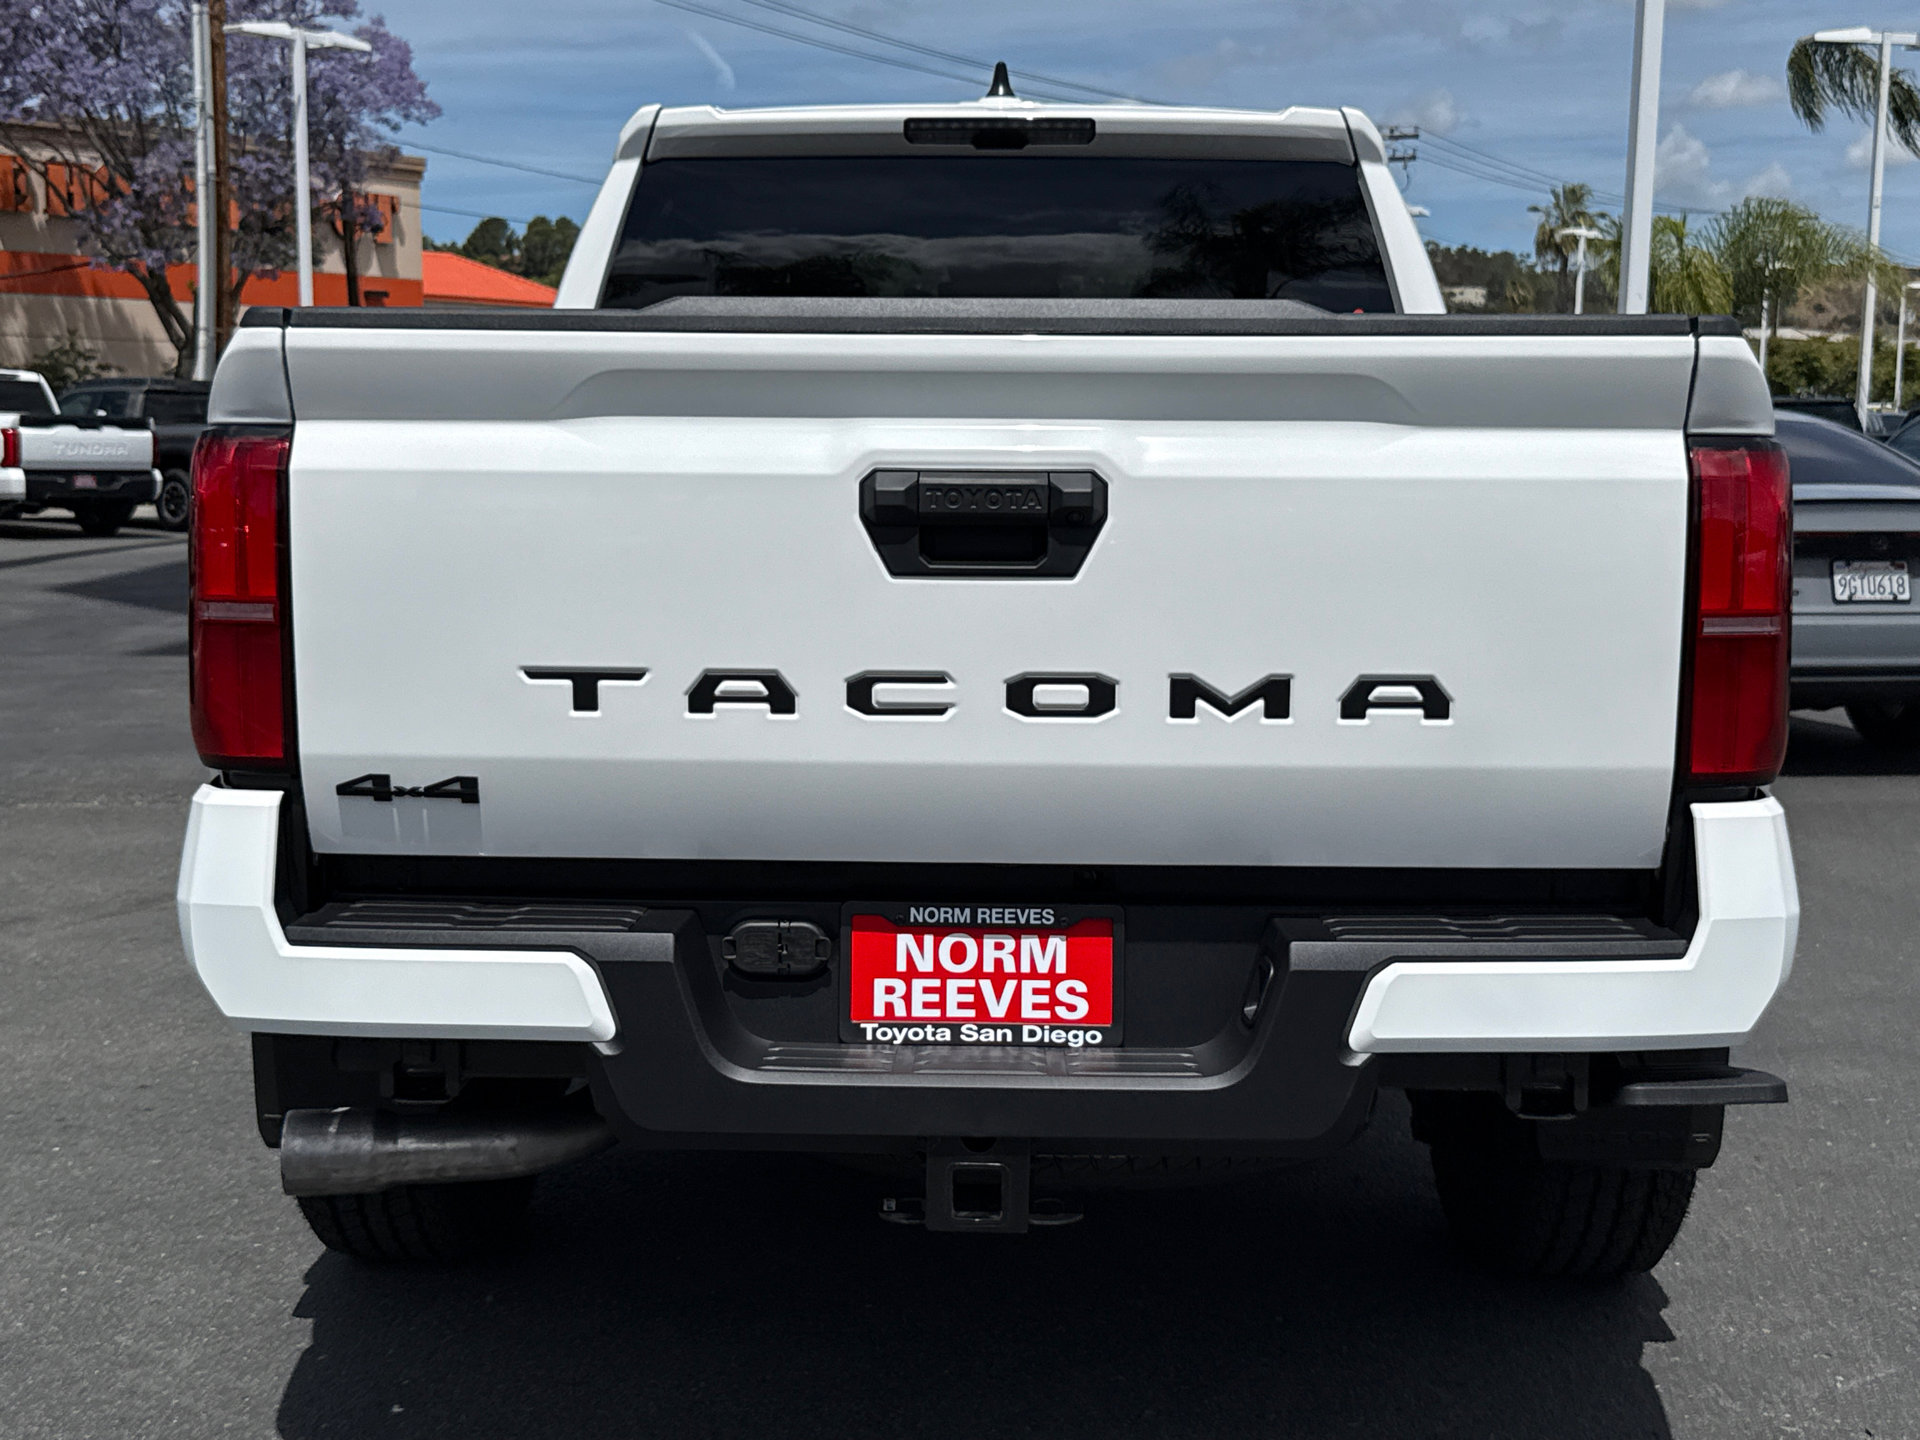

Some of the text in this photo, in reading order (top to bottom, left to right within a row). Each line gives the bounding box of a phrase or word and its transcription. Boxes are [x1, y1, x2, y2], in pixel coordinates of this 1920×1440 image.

[925, 488, 1042, 510] TOYOTA
[519, 665, 1454, 724] TACOMA
[909, 907, 1055, 925] NORM REEVES
[896, 932, 1067, 974] NORM
[873, 978, 1090, 1020] REEVES
[860, 1023, 1103, 1047] Toyota San Diego
